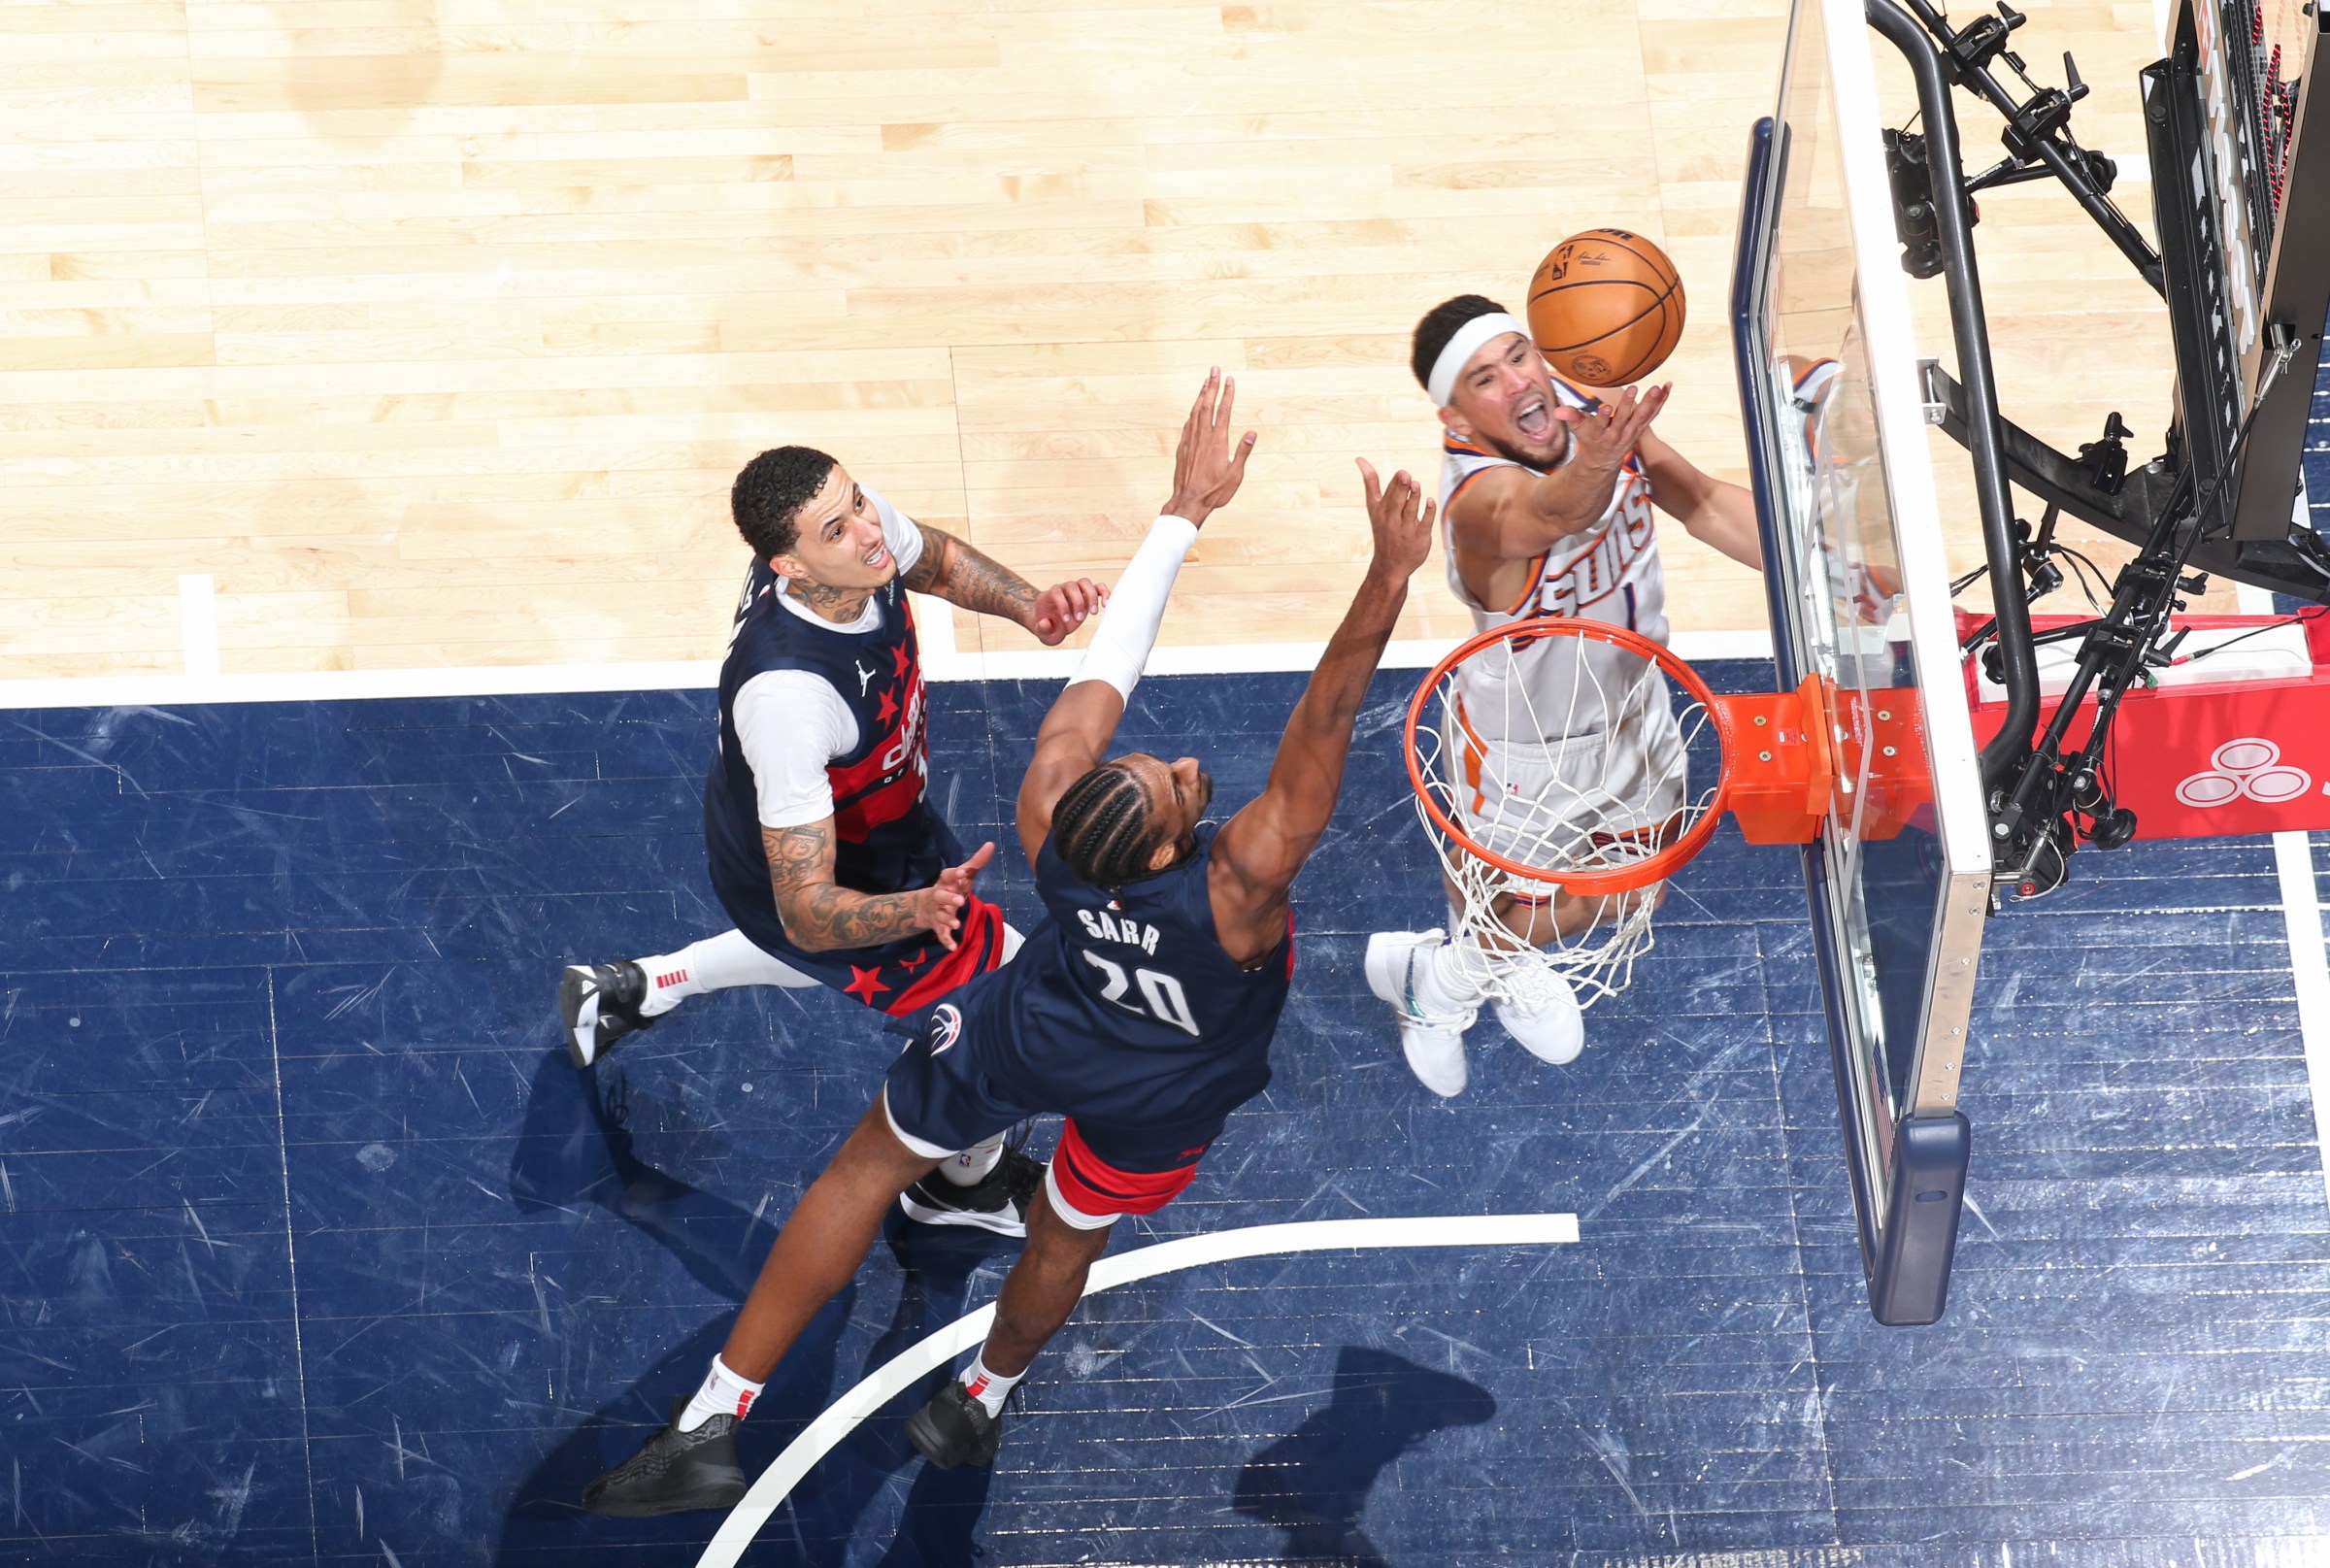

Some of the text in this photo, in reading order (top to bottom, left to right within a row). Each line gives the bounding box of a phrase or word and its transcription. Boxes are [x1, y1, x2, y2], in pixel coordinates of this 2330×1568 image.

[2209, 50, 2257, 354] TISSOT
[1539, 477, 1654, 617] SUNS
[788, 837, 816, 856] 75
[1077, 909, 1161, 956] SARR
[1082, 949, 1201, 1037] 20
